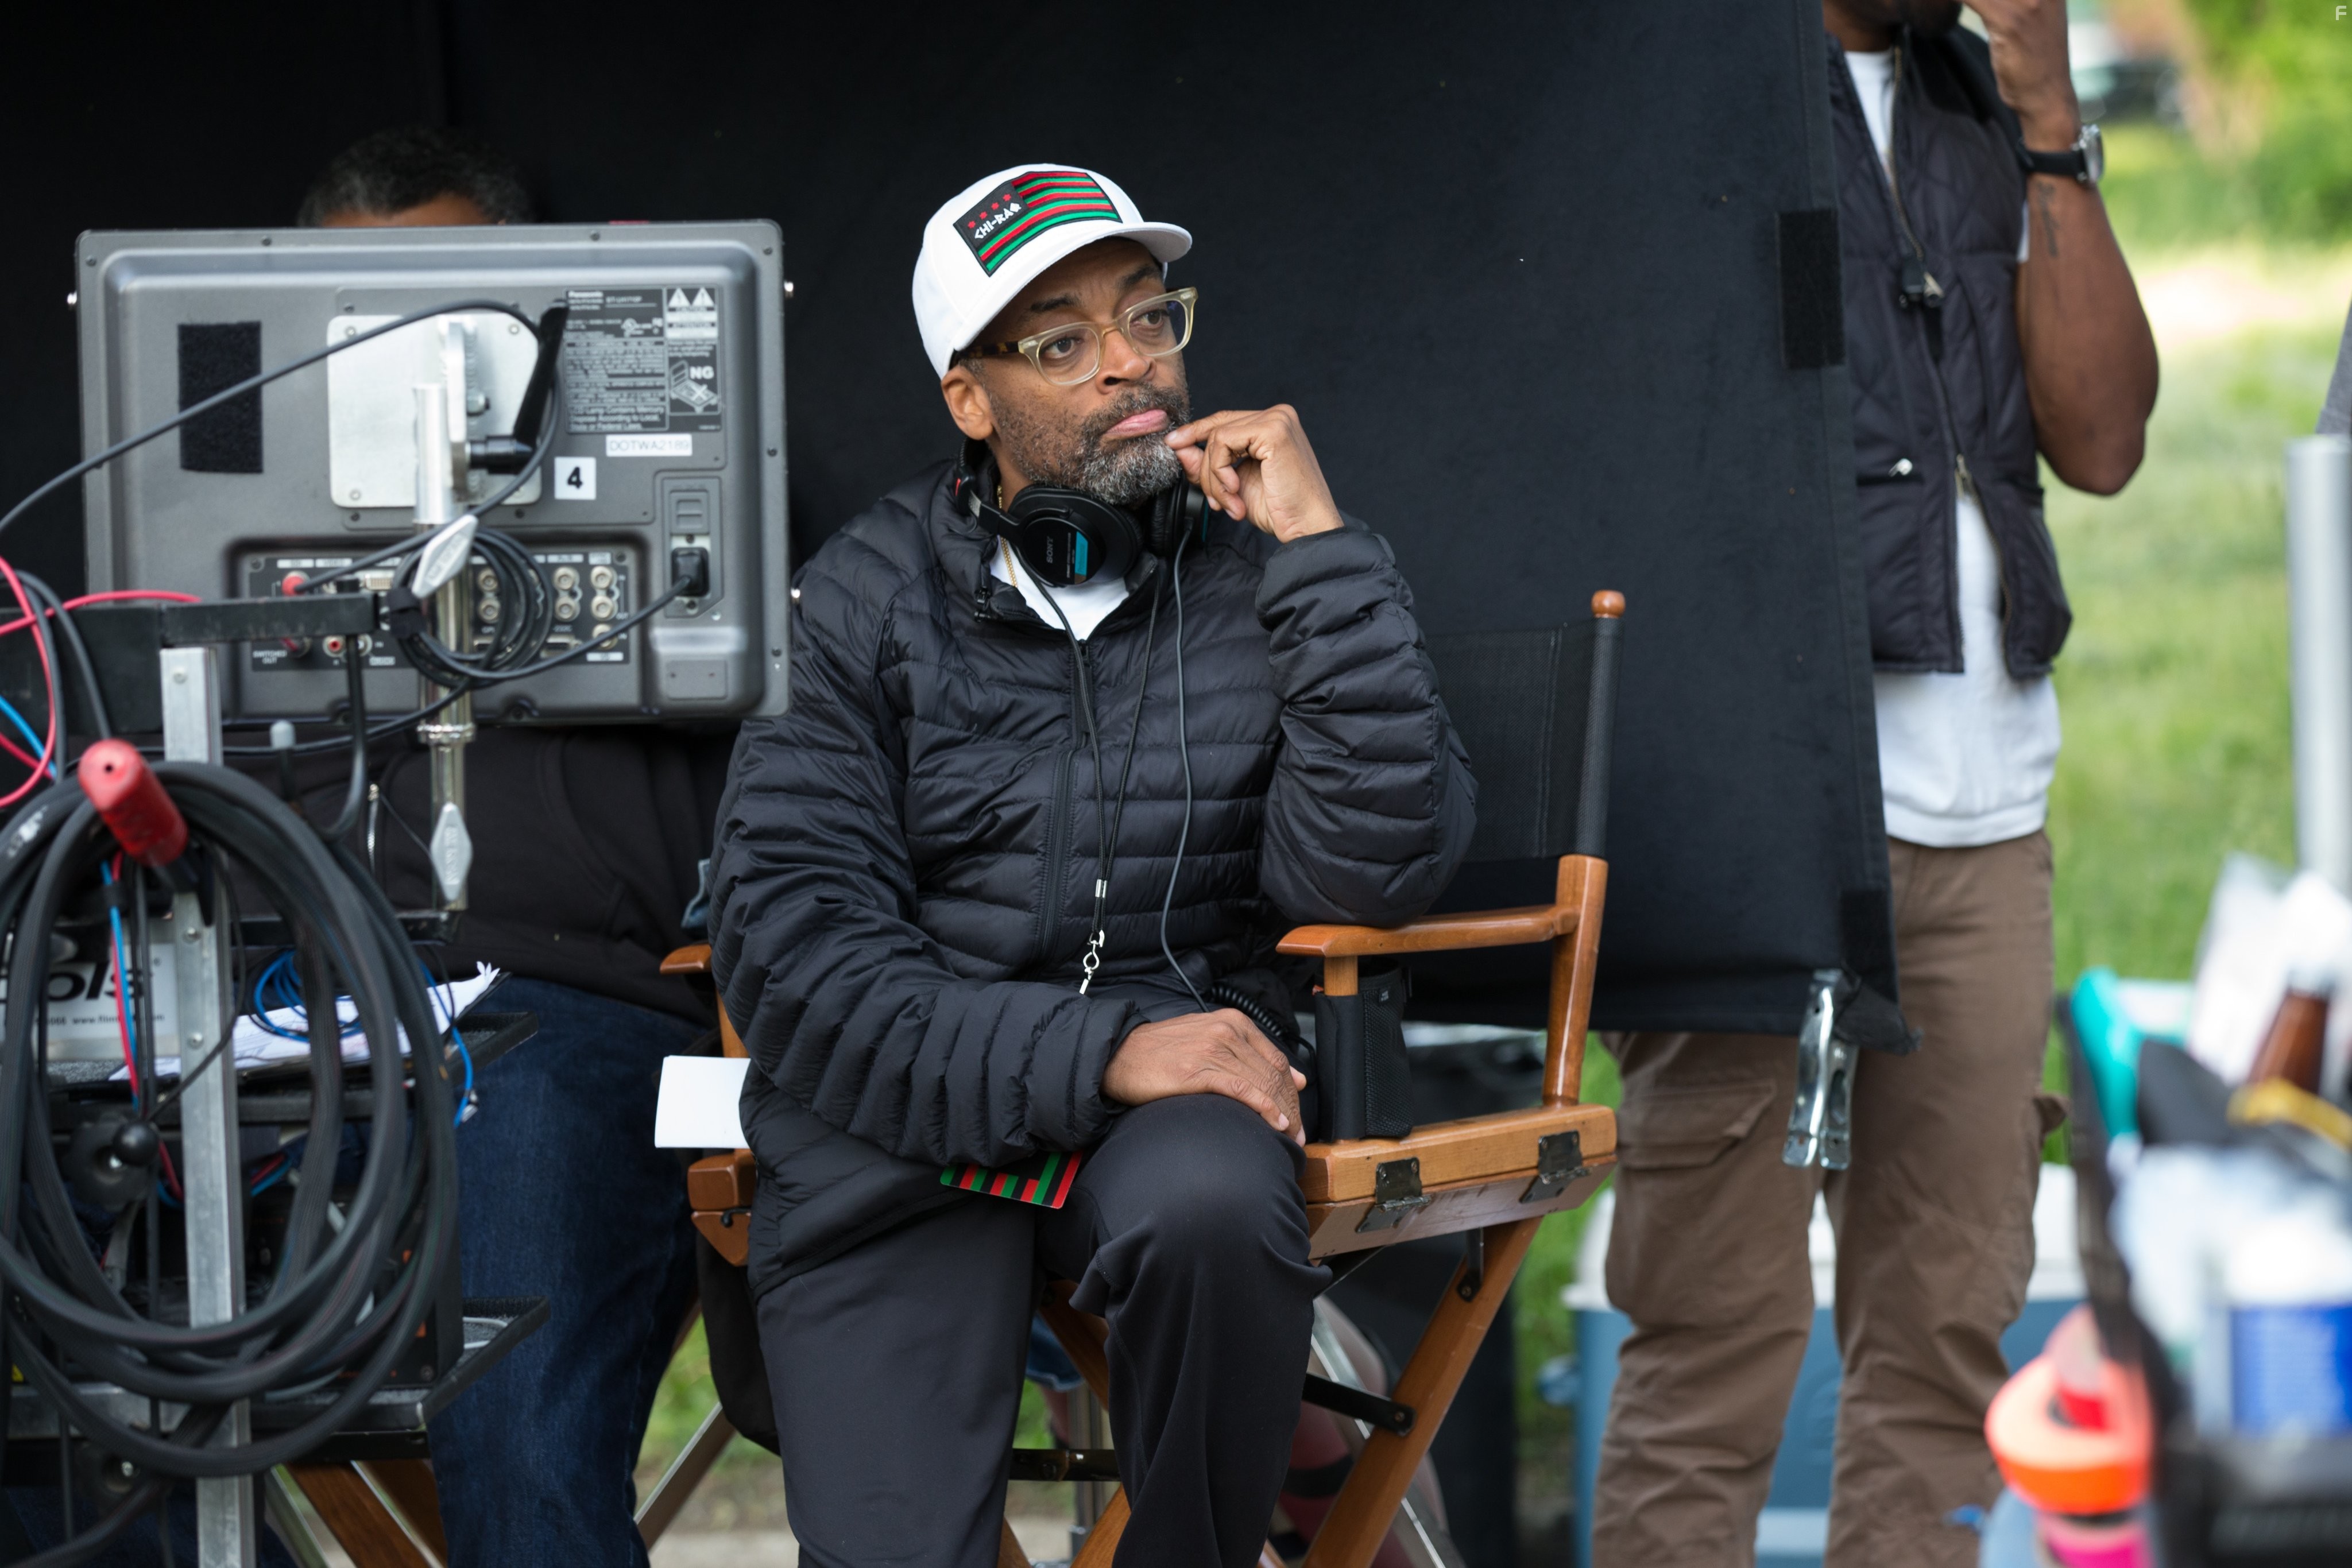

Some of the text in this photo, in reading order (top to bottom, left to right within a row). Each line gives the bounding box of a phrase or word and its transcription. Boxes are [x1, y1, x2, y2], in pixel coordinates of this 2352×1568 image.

[974, 203, 1022, 239] CHI-RAQ
[689, 365, 714, 380] NG
[609, 439, 689, 451] DOTWA2189
[567, 466, 583, 489] 4
[1046, 536, 1054, 564] SONY
